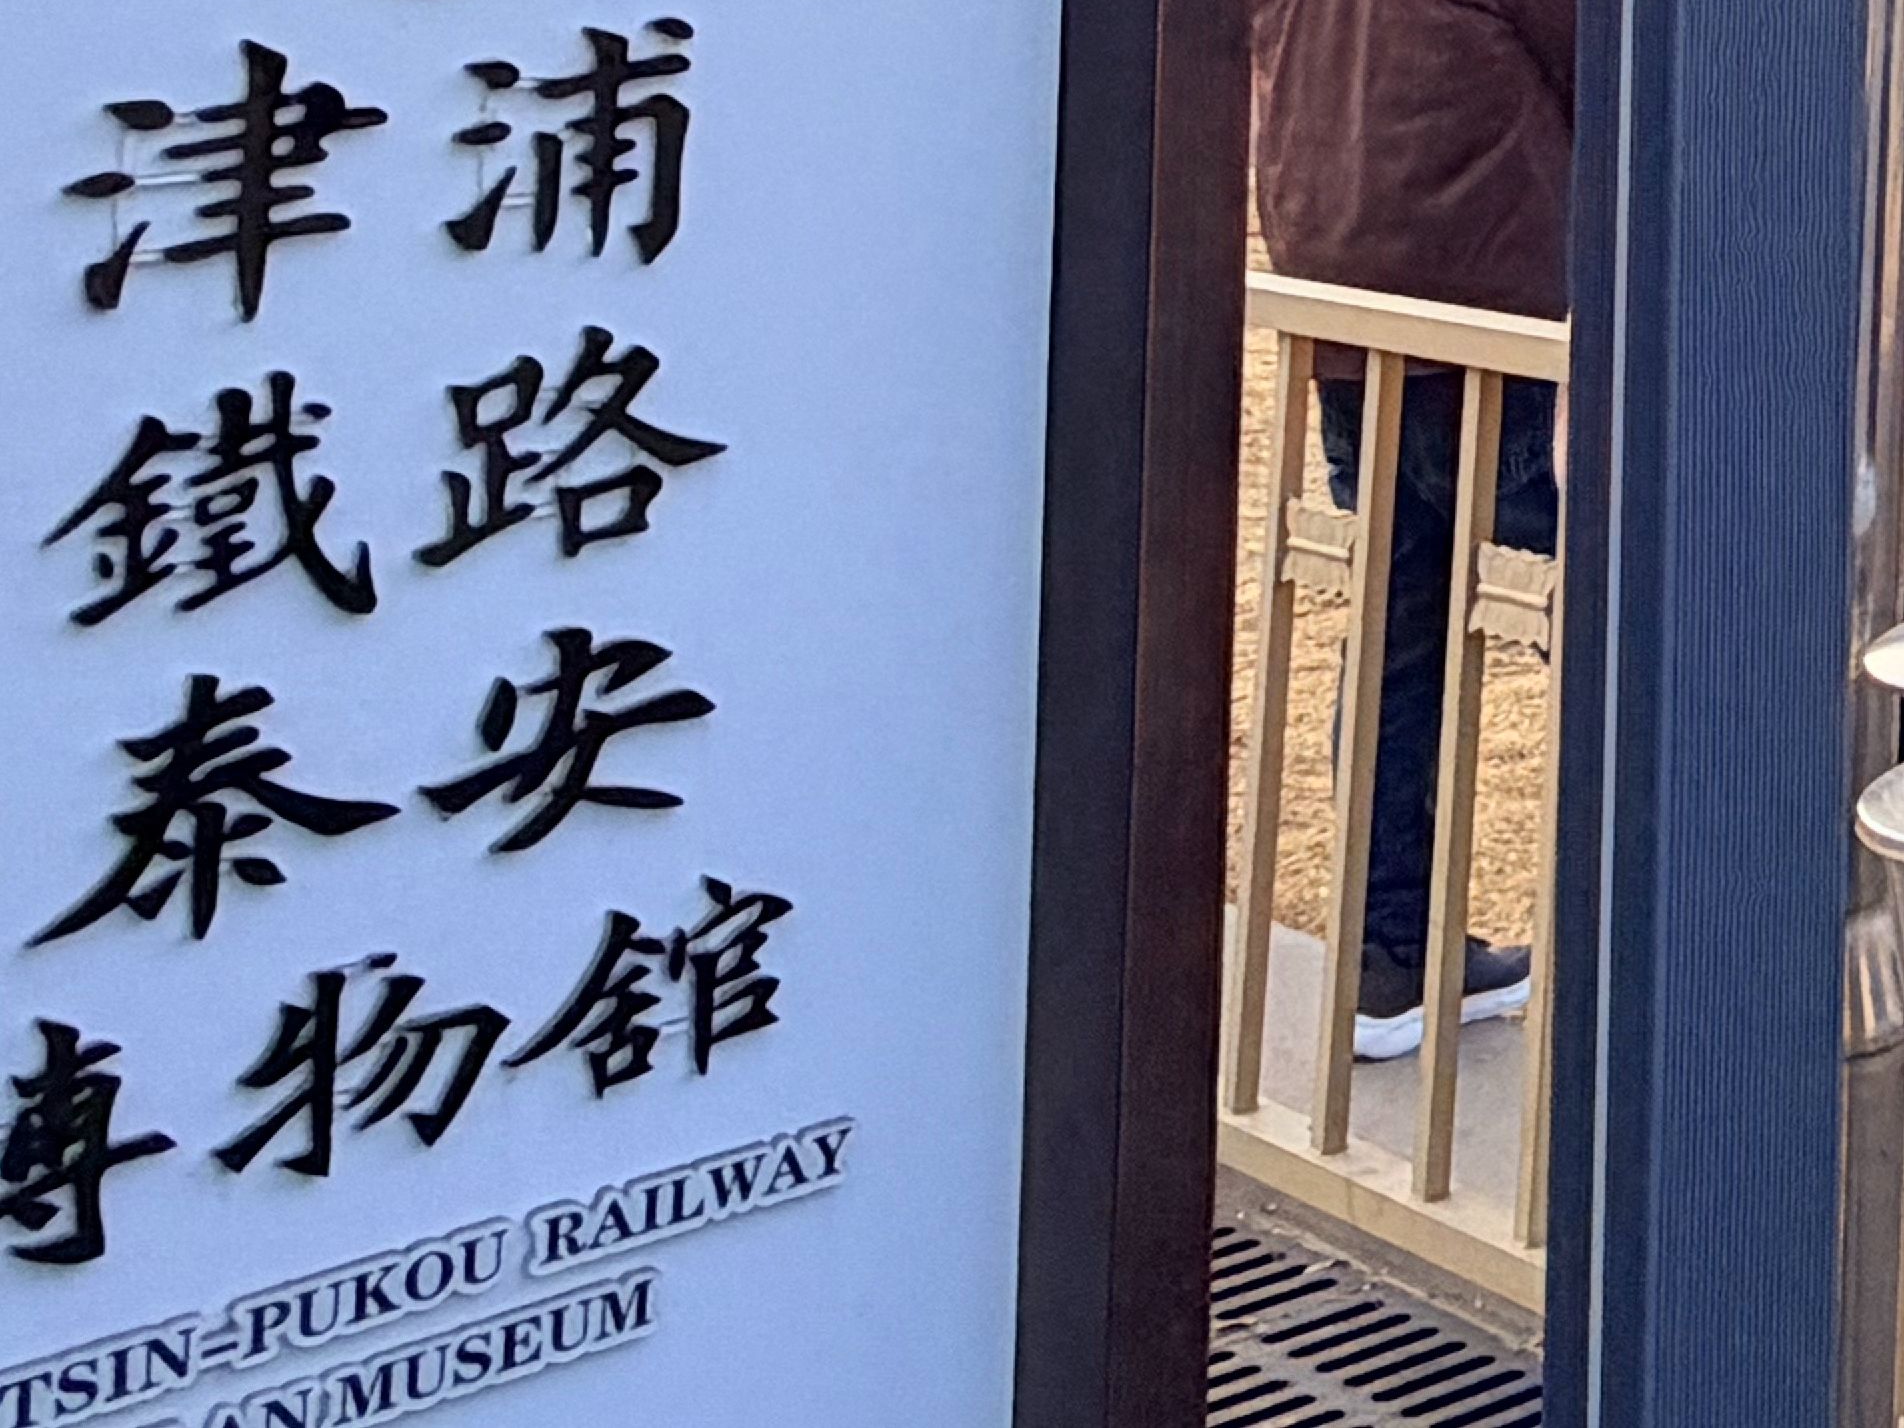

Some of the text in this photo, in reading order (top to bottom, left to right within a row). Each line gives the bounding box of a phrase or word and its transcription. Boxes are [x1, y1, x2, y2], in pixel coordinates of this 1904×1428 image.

[61, 18, 697, 323] 津浦
[39, 326, 729, 627] 鐵路
[21, 627, 718, 949] 泰安
[541, 1126, 856, 1265] RAILWAY
[332, 1277, 657, 1427] MUSEUM
